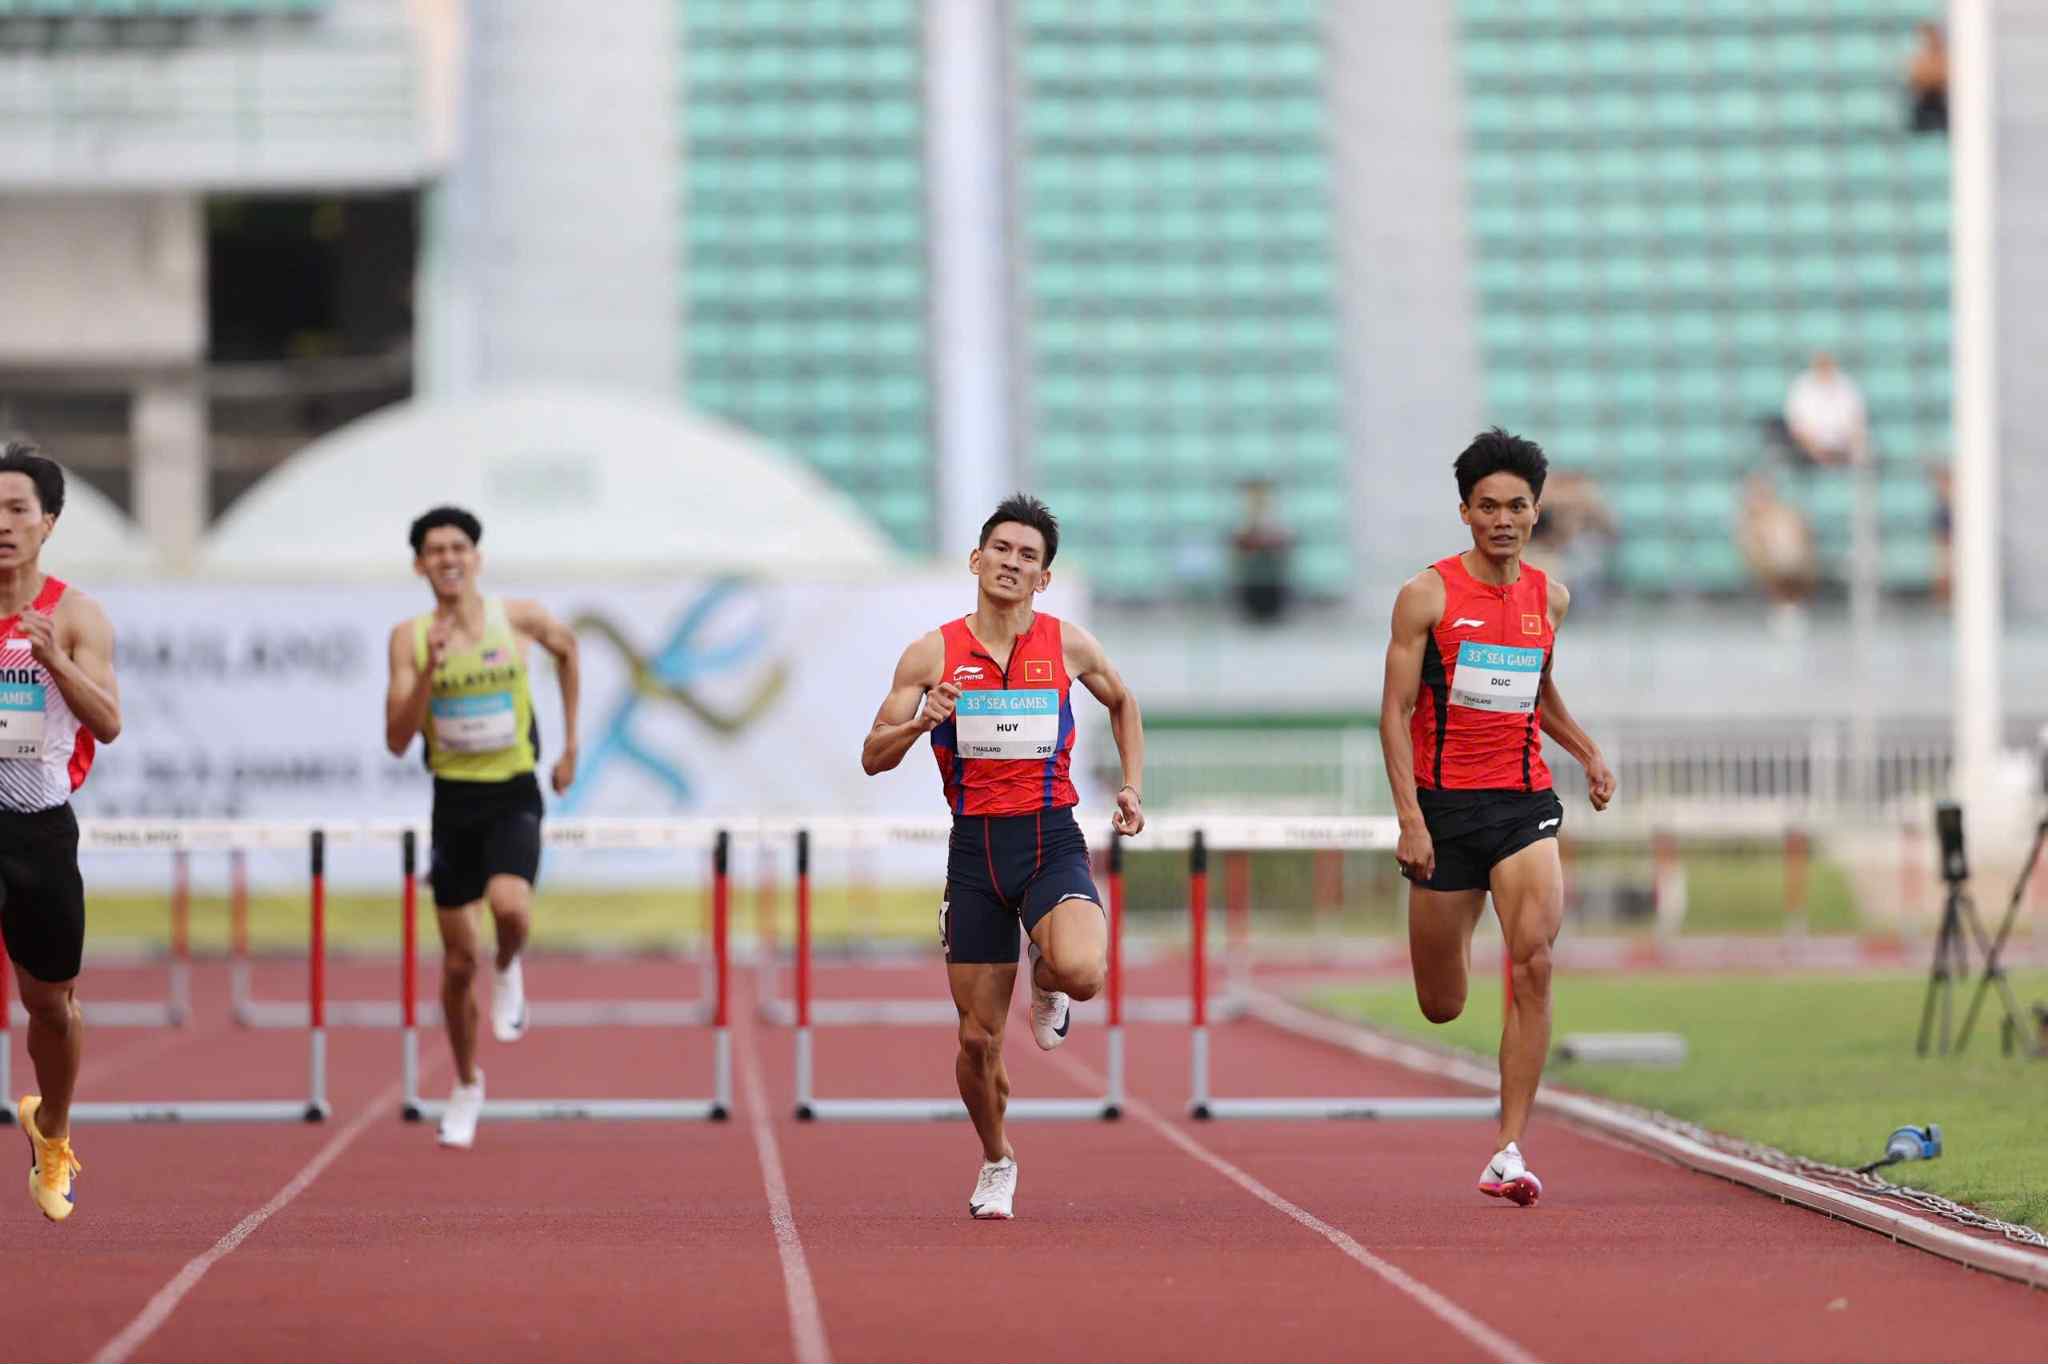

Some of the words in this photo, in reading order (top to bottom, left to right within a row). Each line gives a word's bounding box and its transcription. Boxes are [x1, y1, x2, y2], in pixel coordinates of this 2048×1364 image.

[1491, 677, 1511, 687] DUC
[986, 697, 1007, 710] SEA
[1010, 696, 1048, 709] GAMES
[996, 723, 1019, 732] HUY
